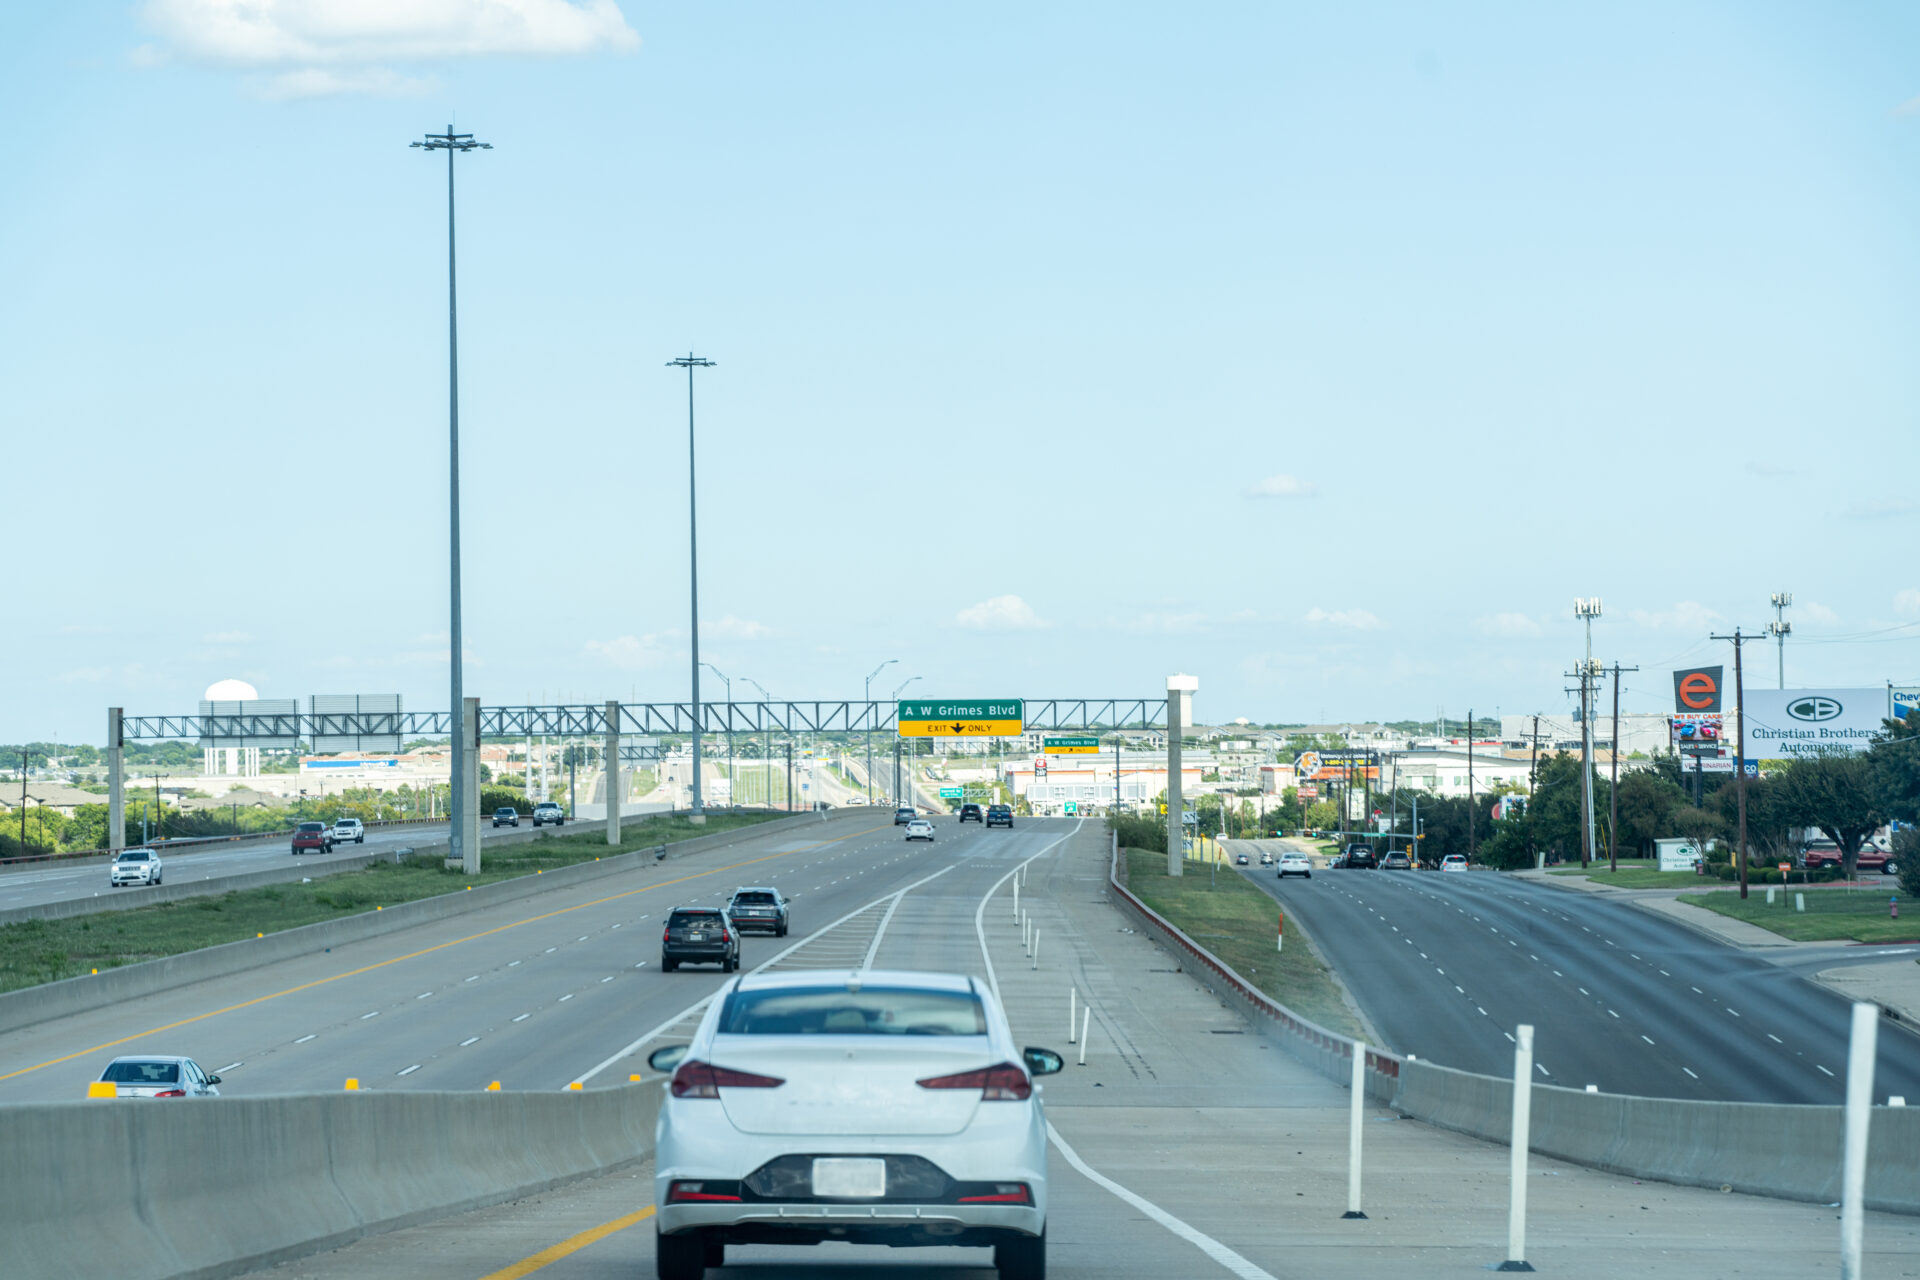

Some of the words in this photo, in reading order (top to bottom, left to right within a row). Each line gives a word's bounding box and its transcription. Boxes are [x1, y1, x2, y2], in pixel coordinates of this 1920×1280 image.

[1679, 673, 1716, 709] e
[1893, 692, 1920, 701] Chev
[905, 706, 914, 716] A
[921, 706, 932, 716] W
[939, 705, 983, 716] Grimes
[989, 705, 1016, 715] Blvd
[1752, 728, 1815, 739] Christian
[1819, 727, 1878, 738] Brothers
[1779, 742, 1853, 753] Automotive
